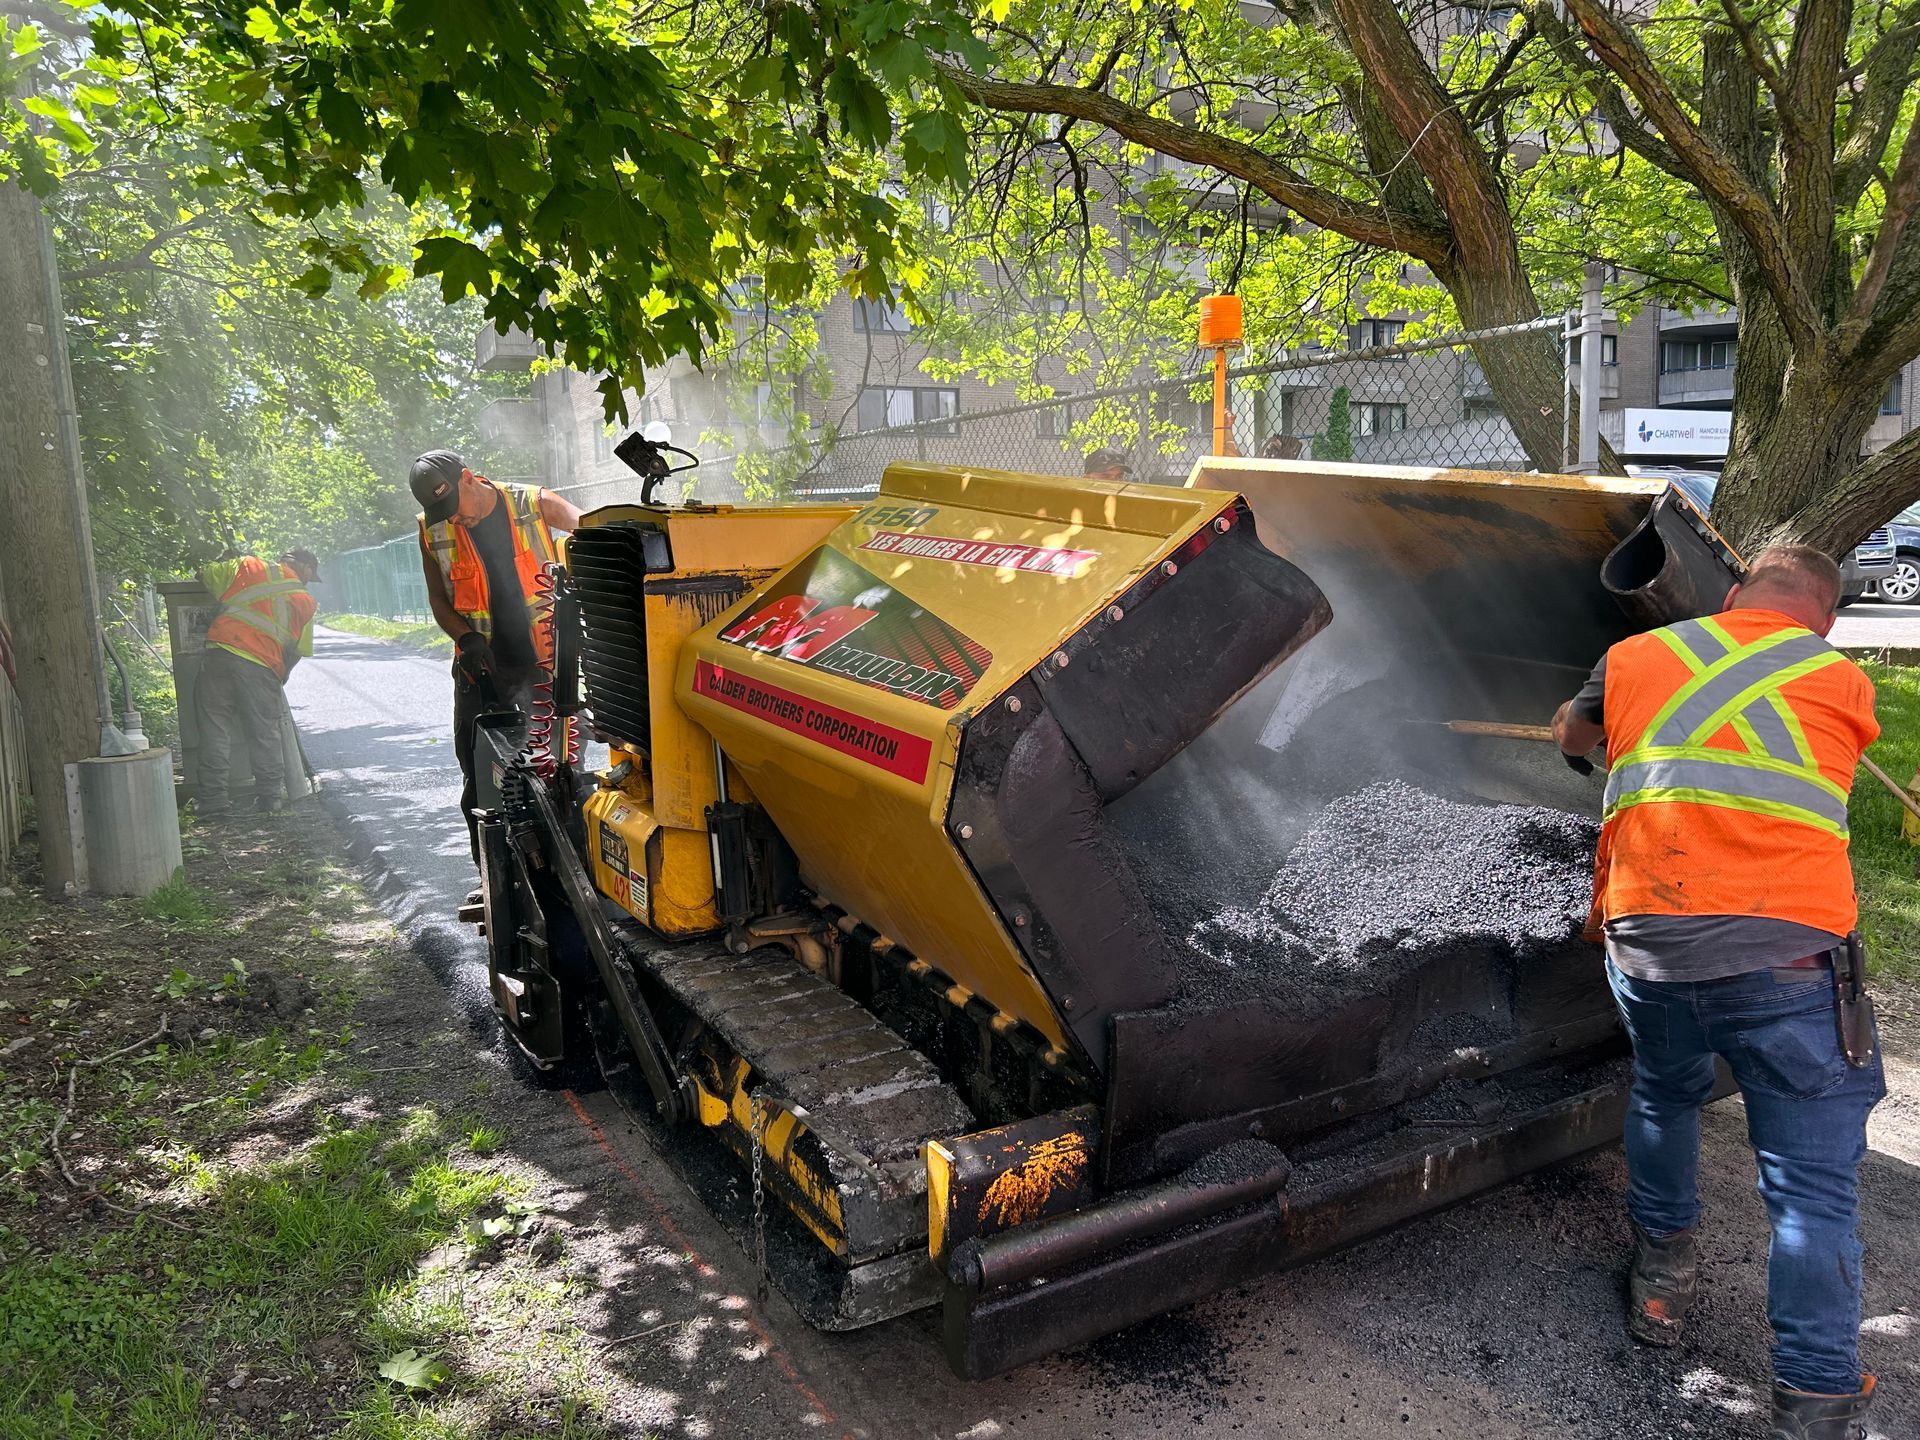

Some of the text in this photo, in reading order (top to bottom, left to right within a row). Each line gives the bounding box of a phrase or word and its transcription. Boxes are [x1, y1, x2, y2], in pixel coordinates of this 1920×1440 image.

[851, 505, 939, 528] 1560
[867, 534, 900, 551] LES
[899, 537, 963, 560] PAVAGES
[957, 544, 984, 562] LA
[981, 547, 1034, 568] CITÉ
[816, 645, 963, 700] MAULDIN
[709, 674, 899, 760] CALDER BROTHERS CORPORATION
